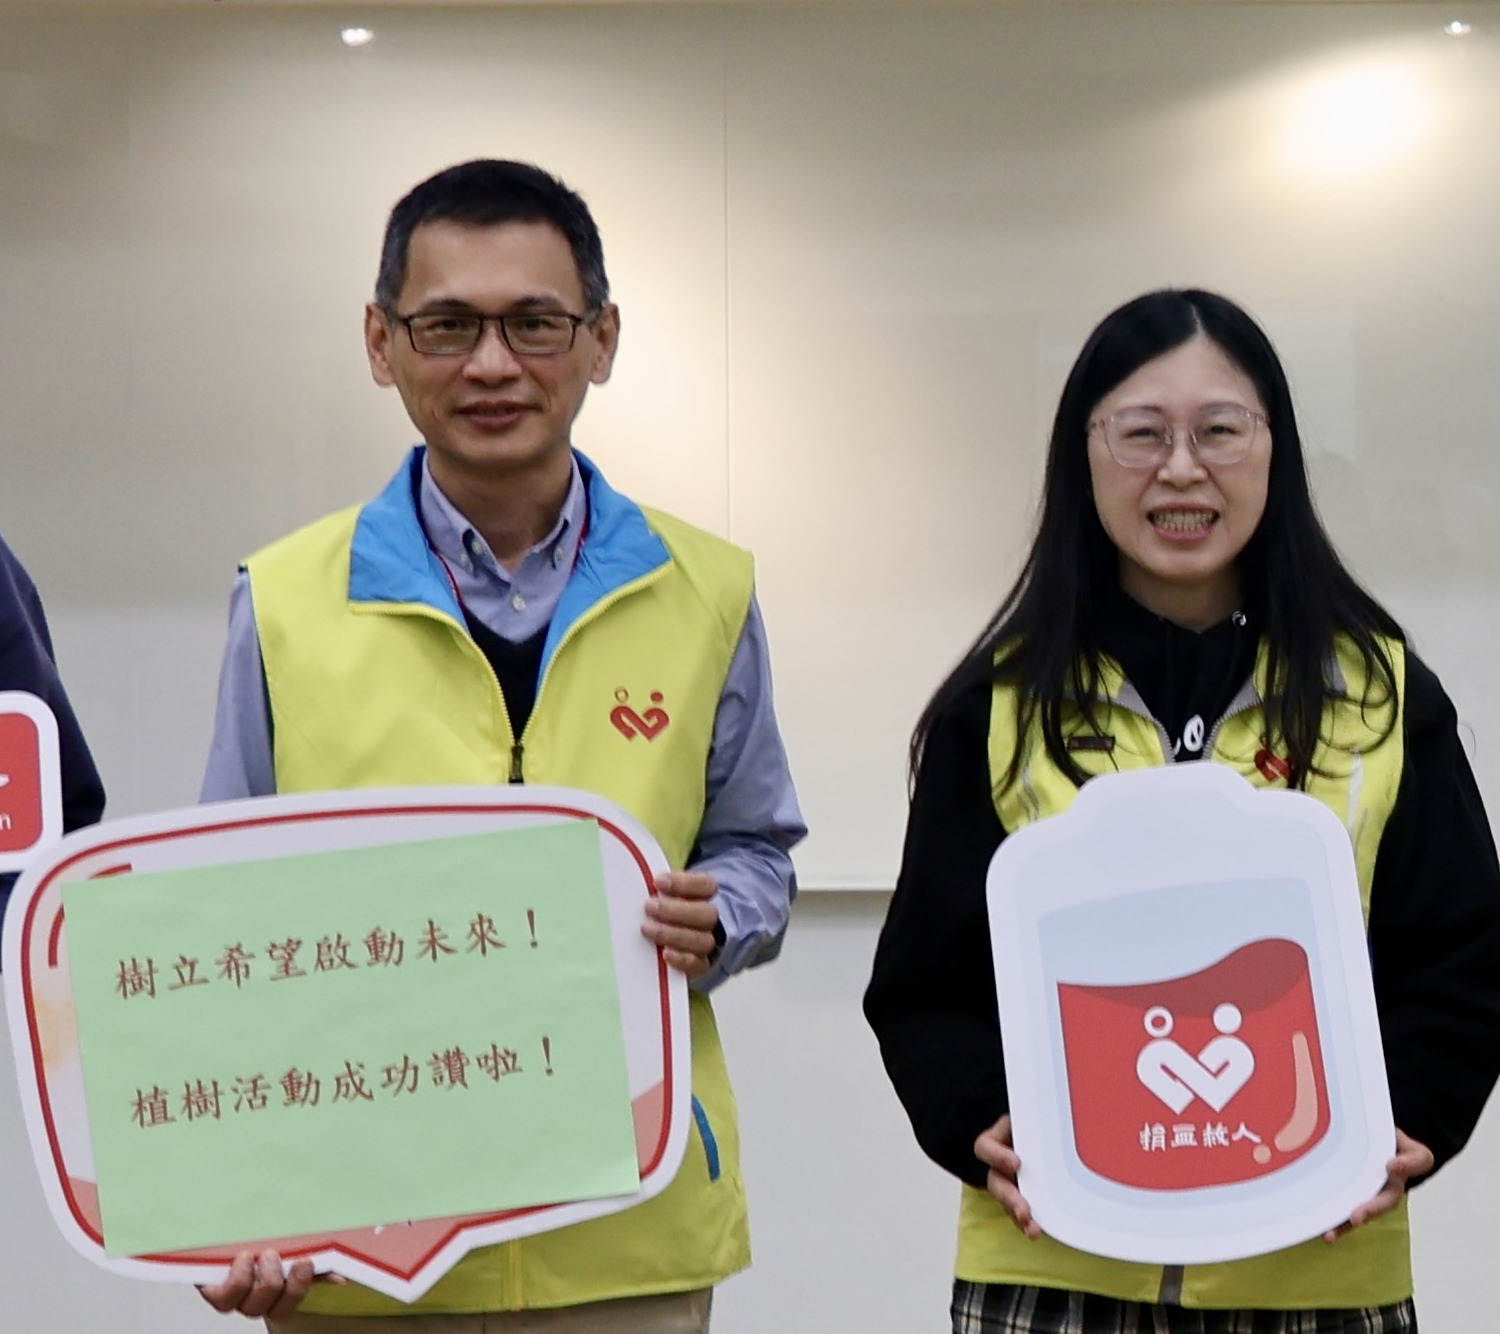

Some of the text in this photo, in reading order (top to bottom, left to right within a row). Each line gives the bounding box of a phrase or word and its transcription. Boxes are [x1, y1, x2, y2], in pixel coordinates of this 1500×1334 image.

[115, 909, 539, 1000] 樹立希望啟動未來！
[130, 1035, 555, 1129] 植樹活動成功讚啦！
[1139, 1122, 1261, 1152] 捐血救人
